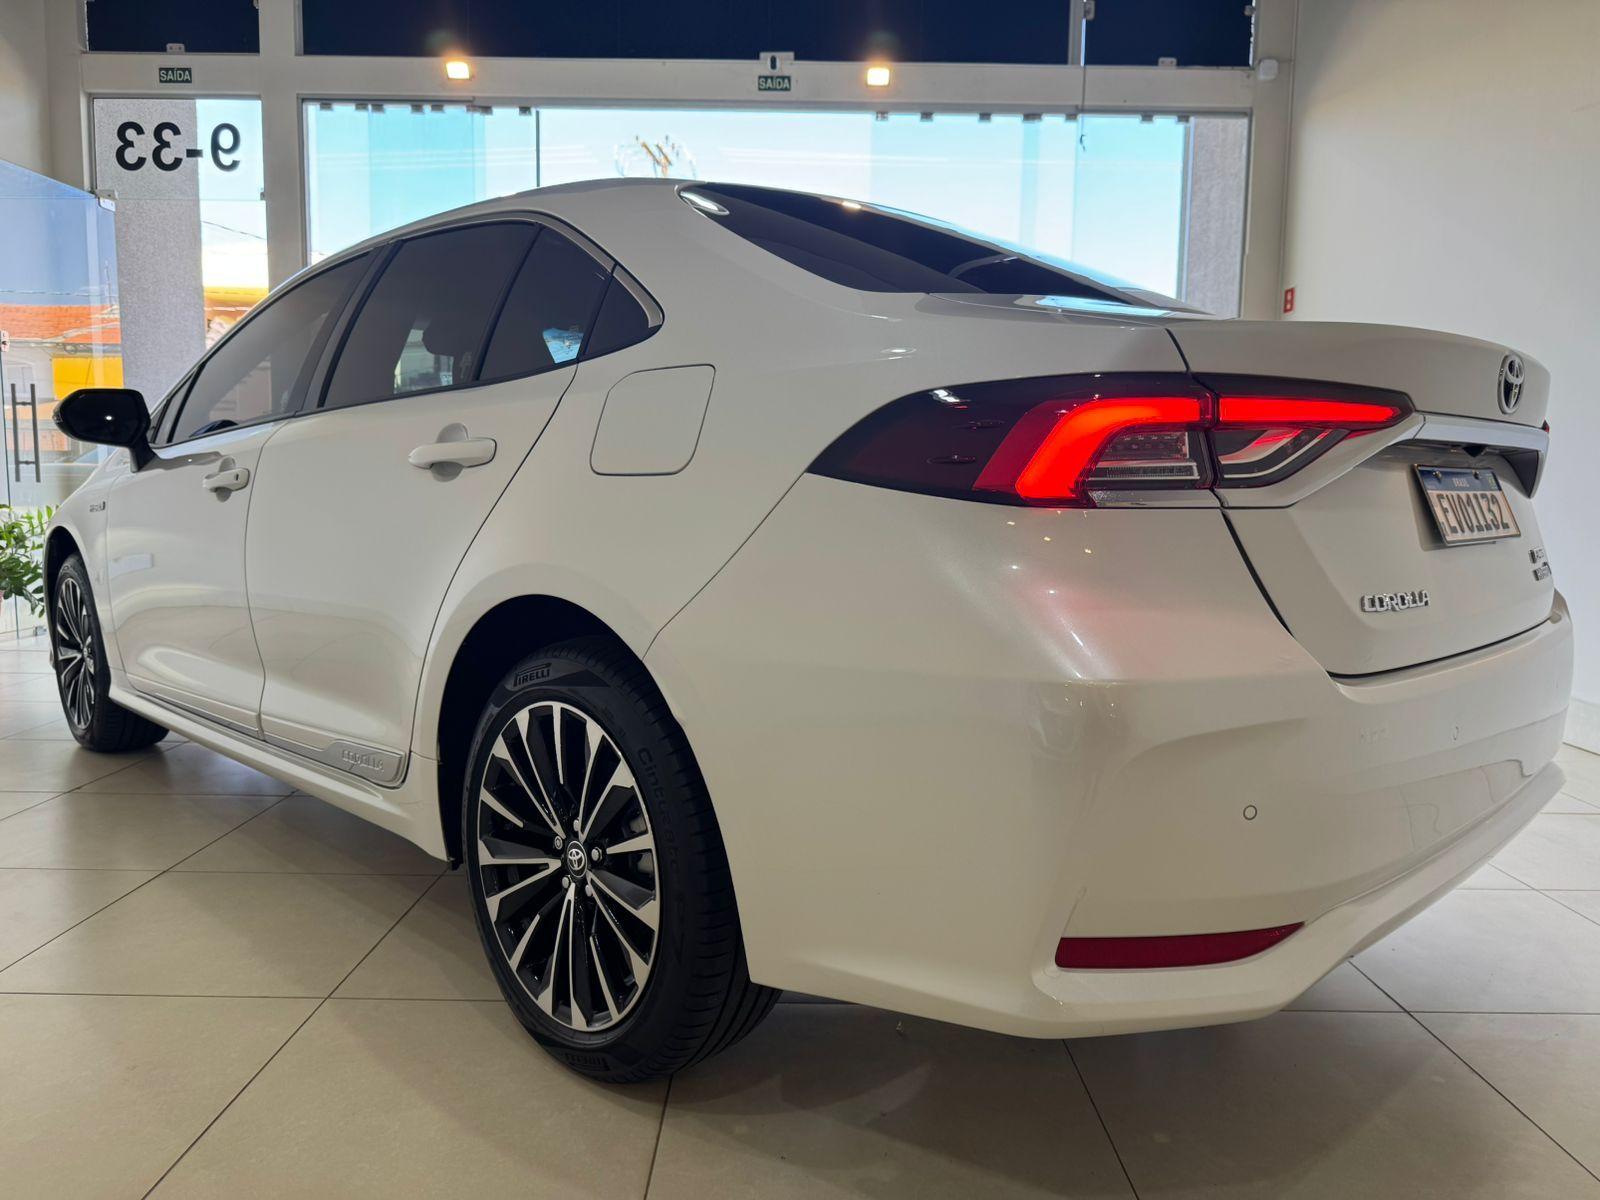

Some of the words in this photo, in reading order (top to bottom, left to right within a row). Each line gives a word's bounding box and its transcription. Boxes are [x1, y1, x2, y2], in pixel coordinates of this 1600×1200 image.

[160, 68, 191, 81] SAÍDA
[759, 76, 790, 89] SAÍDA
[1360, 589, 1430, 612] COROLLA
[512, 662, 552, 688] PIRELLI
